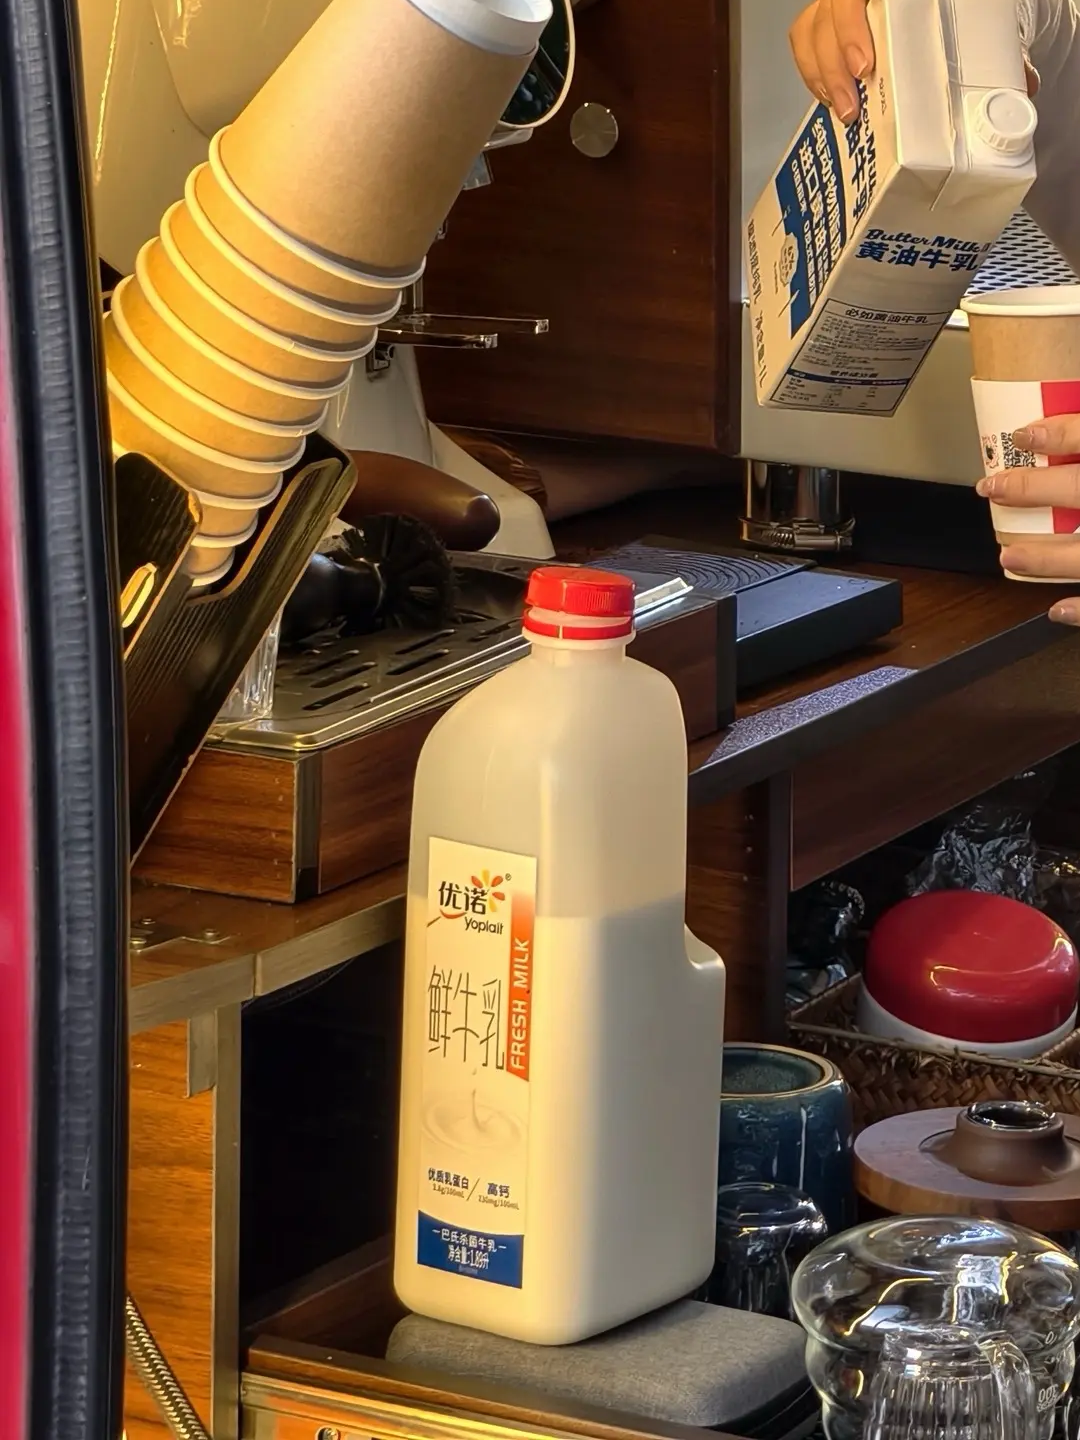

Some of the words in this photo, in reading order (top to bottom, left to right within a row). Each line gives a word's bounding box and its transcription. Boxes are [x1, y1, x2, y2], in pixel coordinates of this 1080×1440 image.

[844, 118, 870, 220] 油牛乳
[855, 241, 979, 272] 黄油牛乳
[865, 228, 930, 244] Butter
[930, 236, 981, 253] Milk
[438, 880, 488, 915] 优诺
[513, 938, 530, 989] MILK
[510, 999, 528, 1070] FRESH
